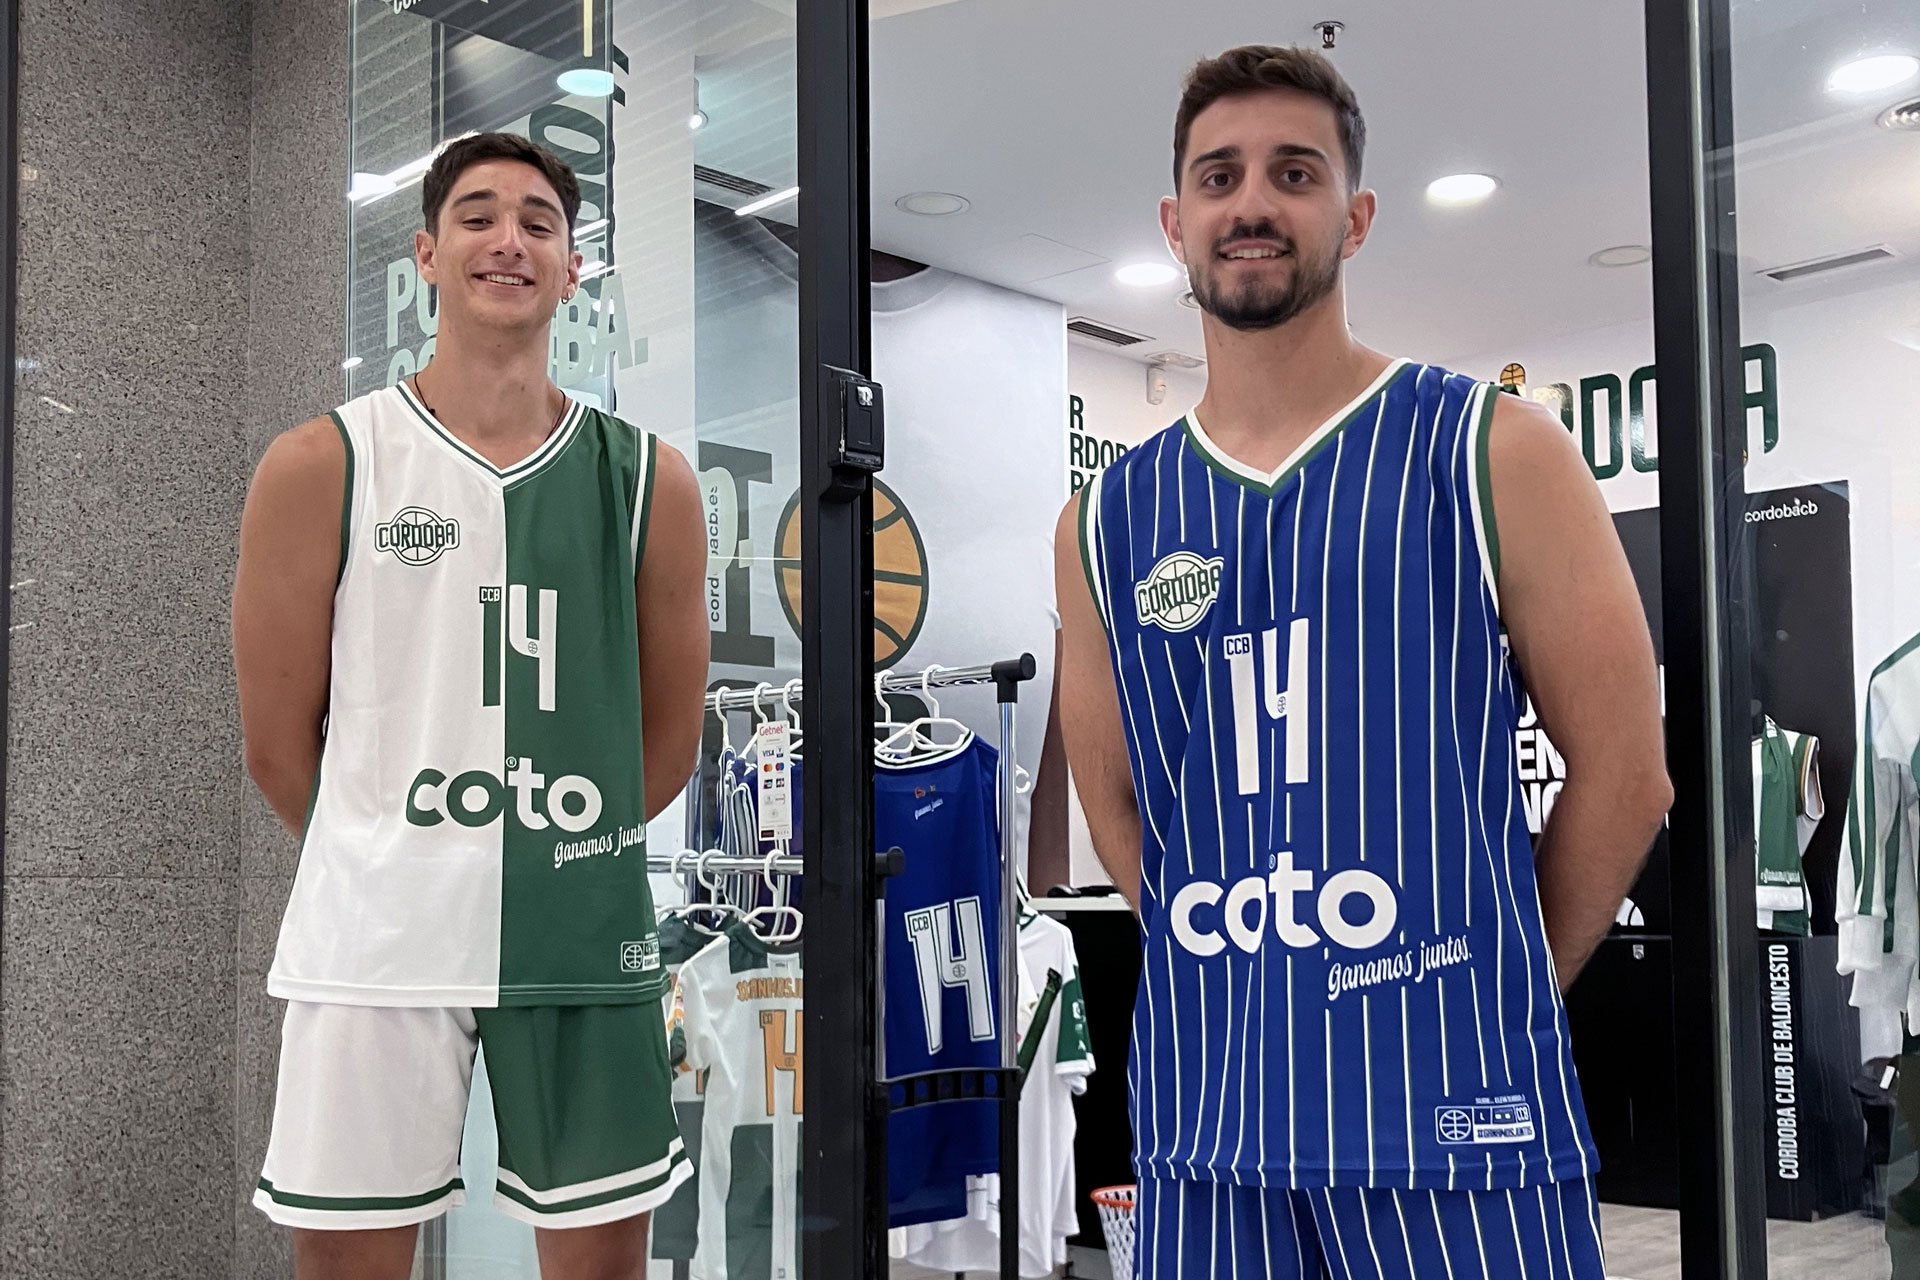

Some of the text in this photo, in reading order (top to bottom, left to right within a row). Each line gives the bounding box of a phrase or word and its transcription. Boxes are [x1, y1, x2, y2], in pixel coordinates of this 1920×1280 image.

[479, 584, 558, 712] 14
[480, 587, 501, 602] CCB
[1226, 636, 1250, 656] CCB
[1223, 617, 1309, 796] 14
[406, 756, 603, 833] coto
[911, 915, 930, 933] CCB
[1170, 850, 1398, 957] coto
[904, 895, 996, 1056] 14
[1768, 943, 1800, 1180] CORDOBA CLUB DE BALONCESTO
